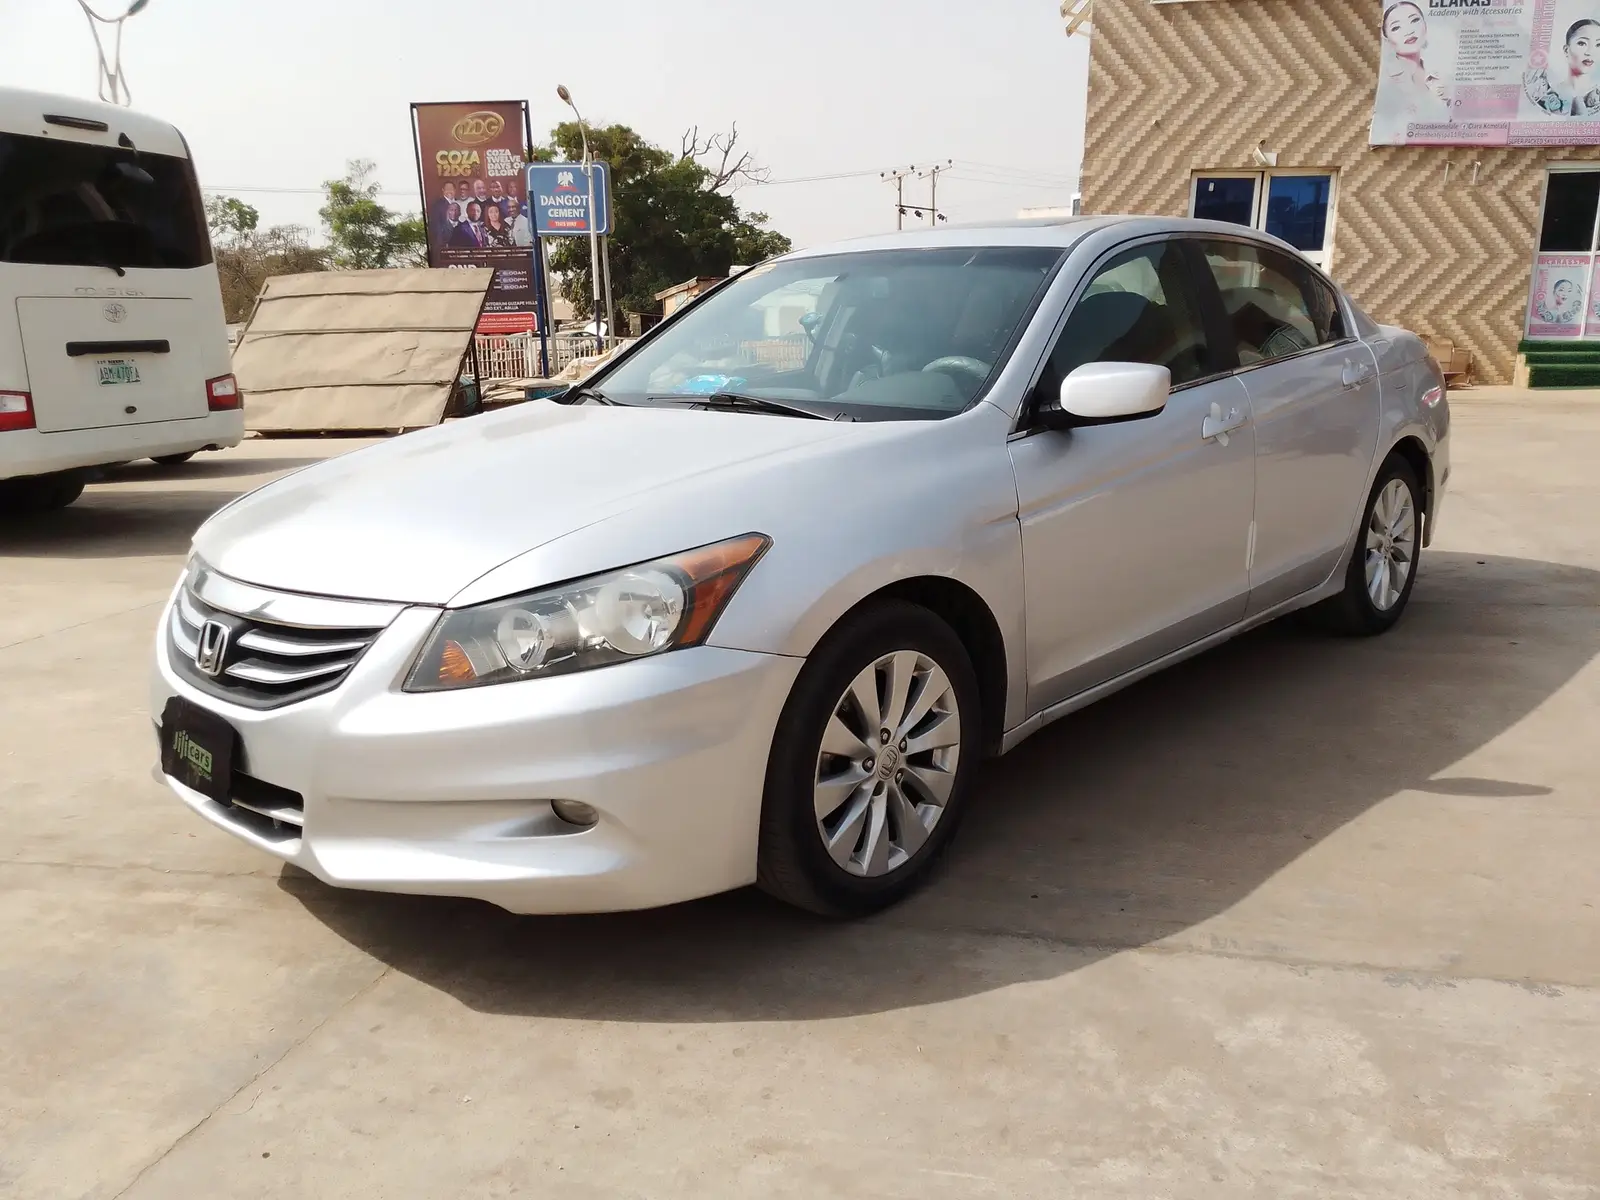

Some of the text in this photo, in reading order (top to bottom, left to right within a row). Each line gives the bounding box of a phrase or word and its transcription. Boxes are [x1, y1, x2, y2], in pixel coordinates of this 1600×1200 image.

[1428, 9, 1461, 17] Academy
[1480, 7, 1523, 15] Accessories
[436, 150, 480, 165] COZA
[437, 164, 472, 177] 12DG
[540, 195, 588, 206] DANGOT
[548, 209, 585, 218] CEMENT
